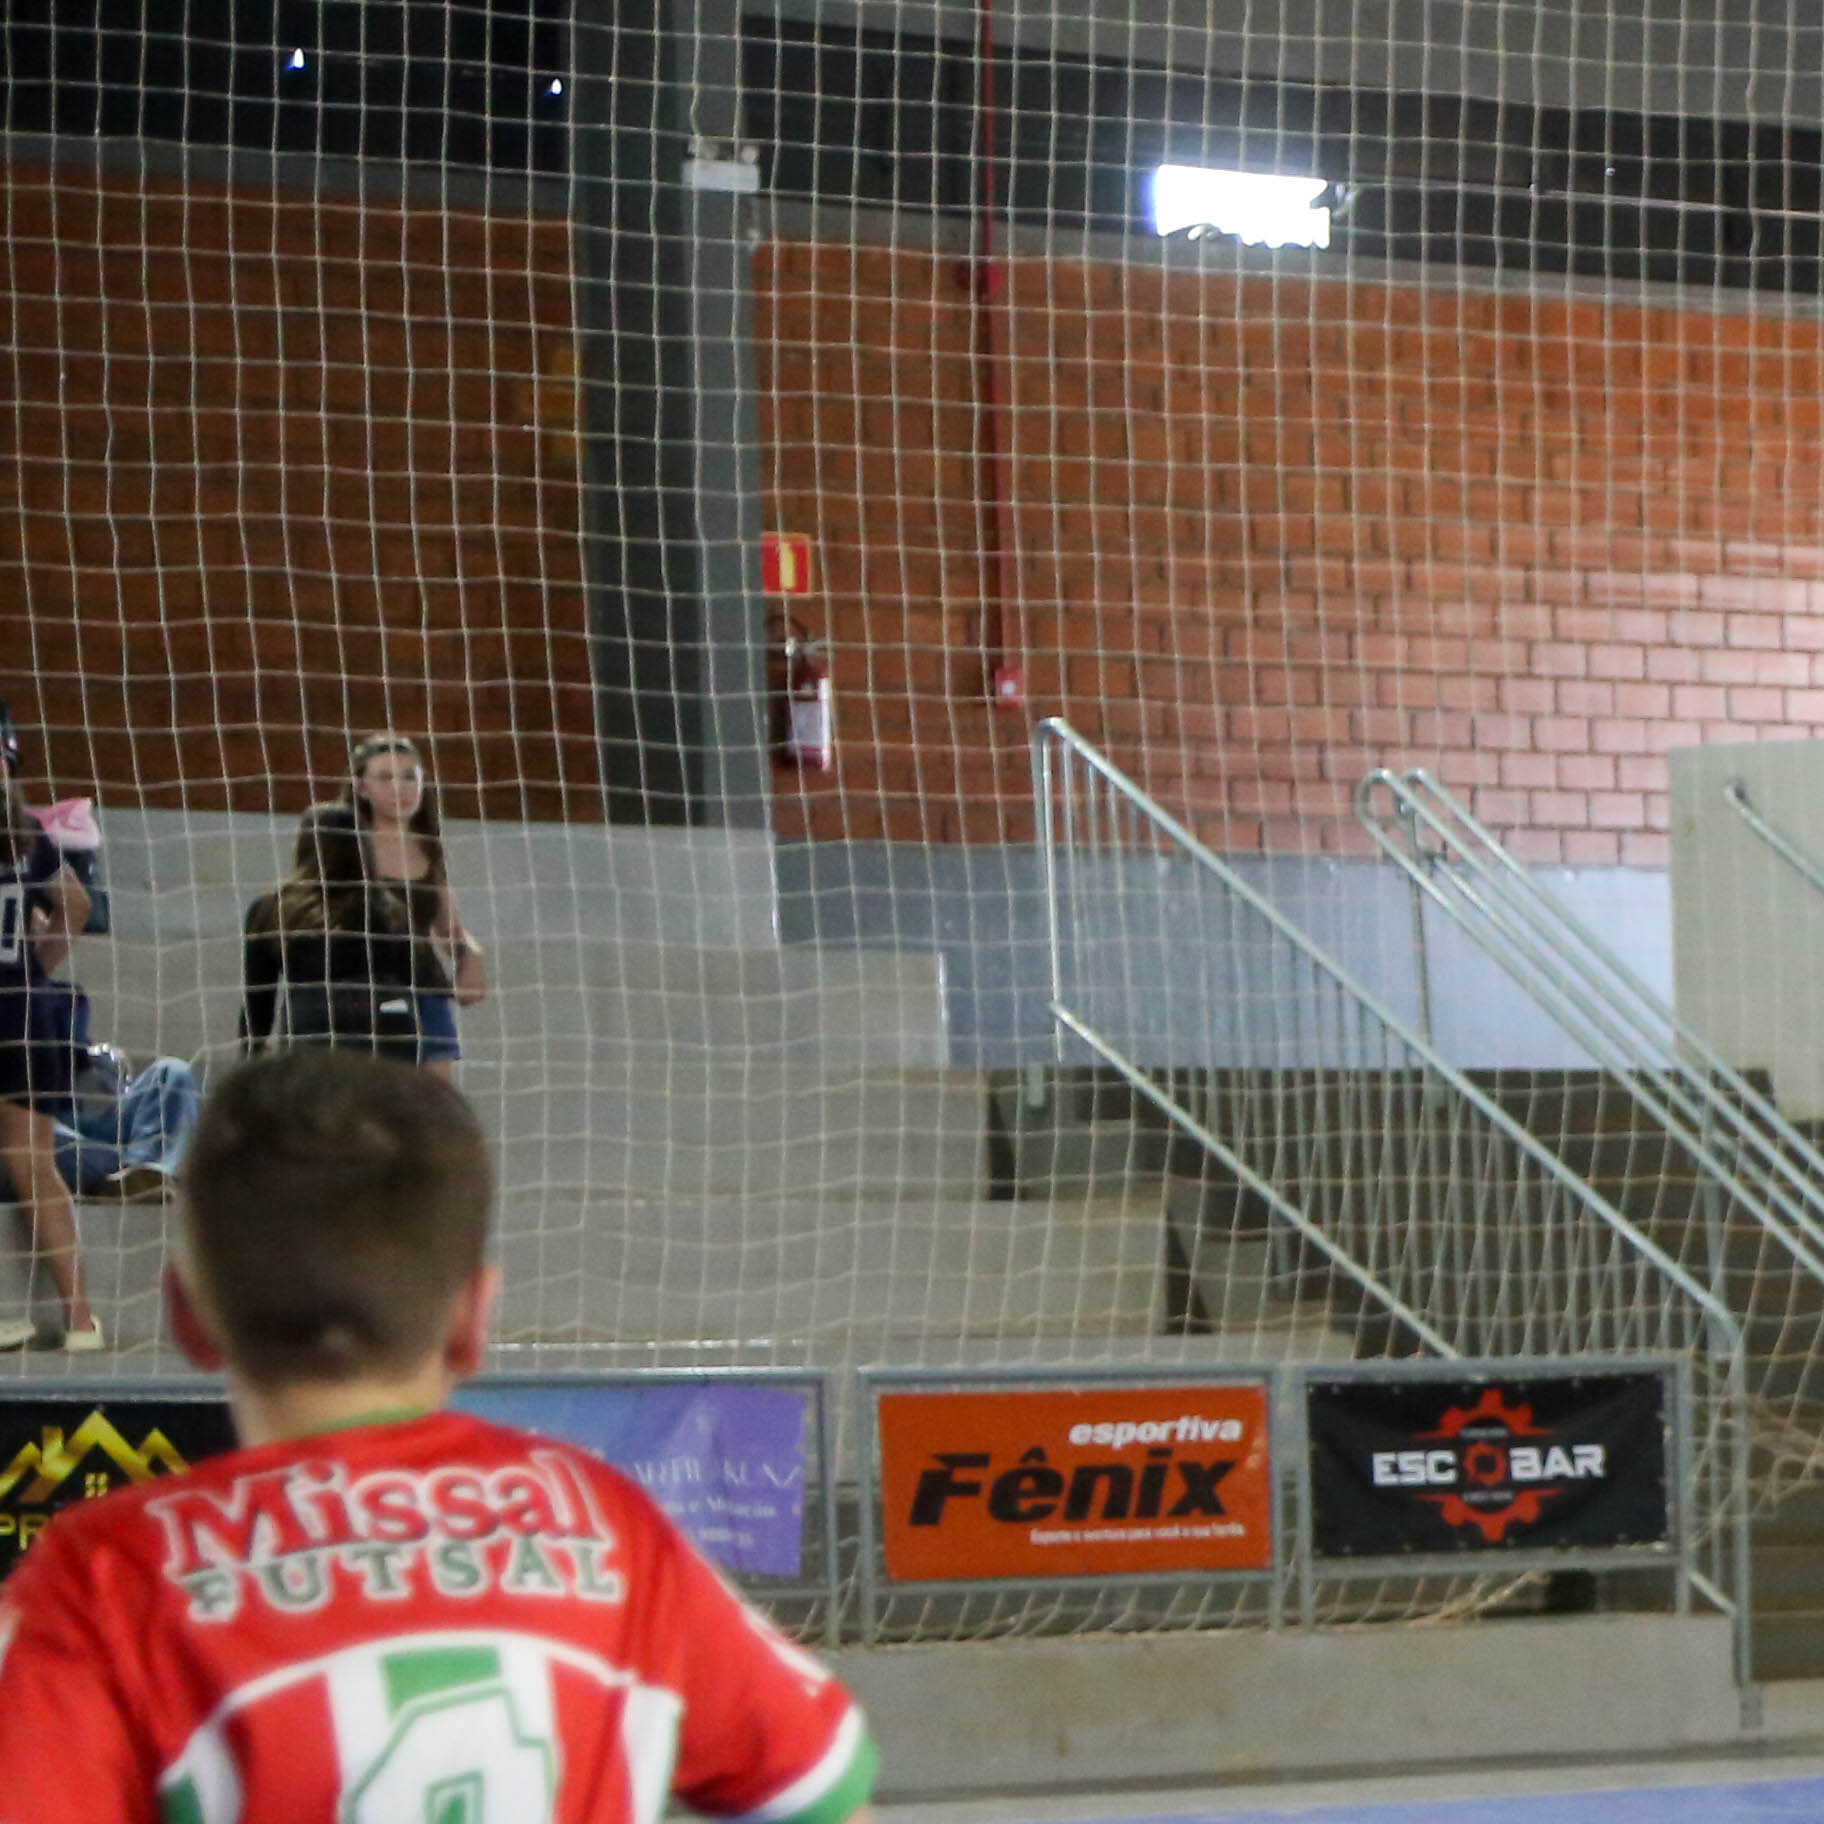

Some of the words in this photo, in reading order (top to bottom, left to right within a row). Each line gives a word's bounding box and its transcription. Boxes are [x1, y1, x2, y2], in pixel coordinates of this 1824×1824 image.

[1069, 1413, 1243, 1448] esportiva
[146, 1451, 612, 1580] Missal
[909, 1447, 1239, 1527] Fênix
[185, 1540, 624, 1624] FUTSAL
